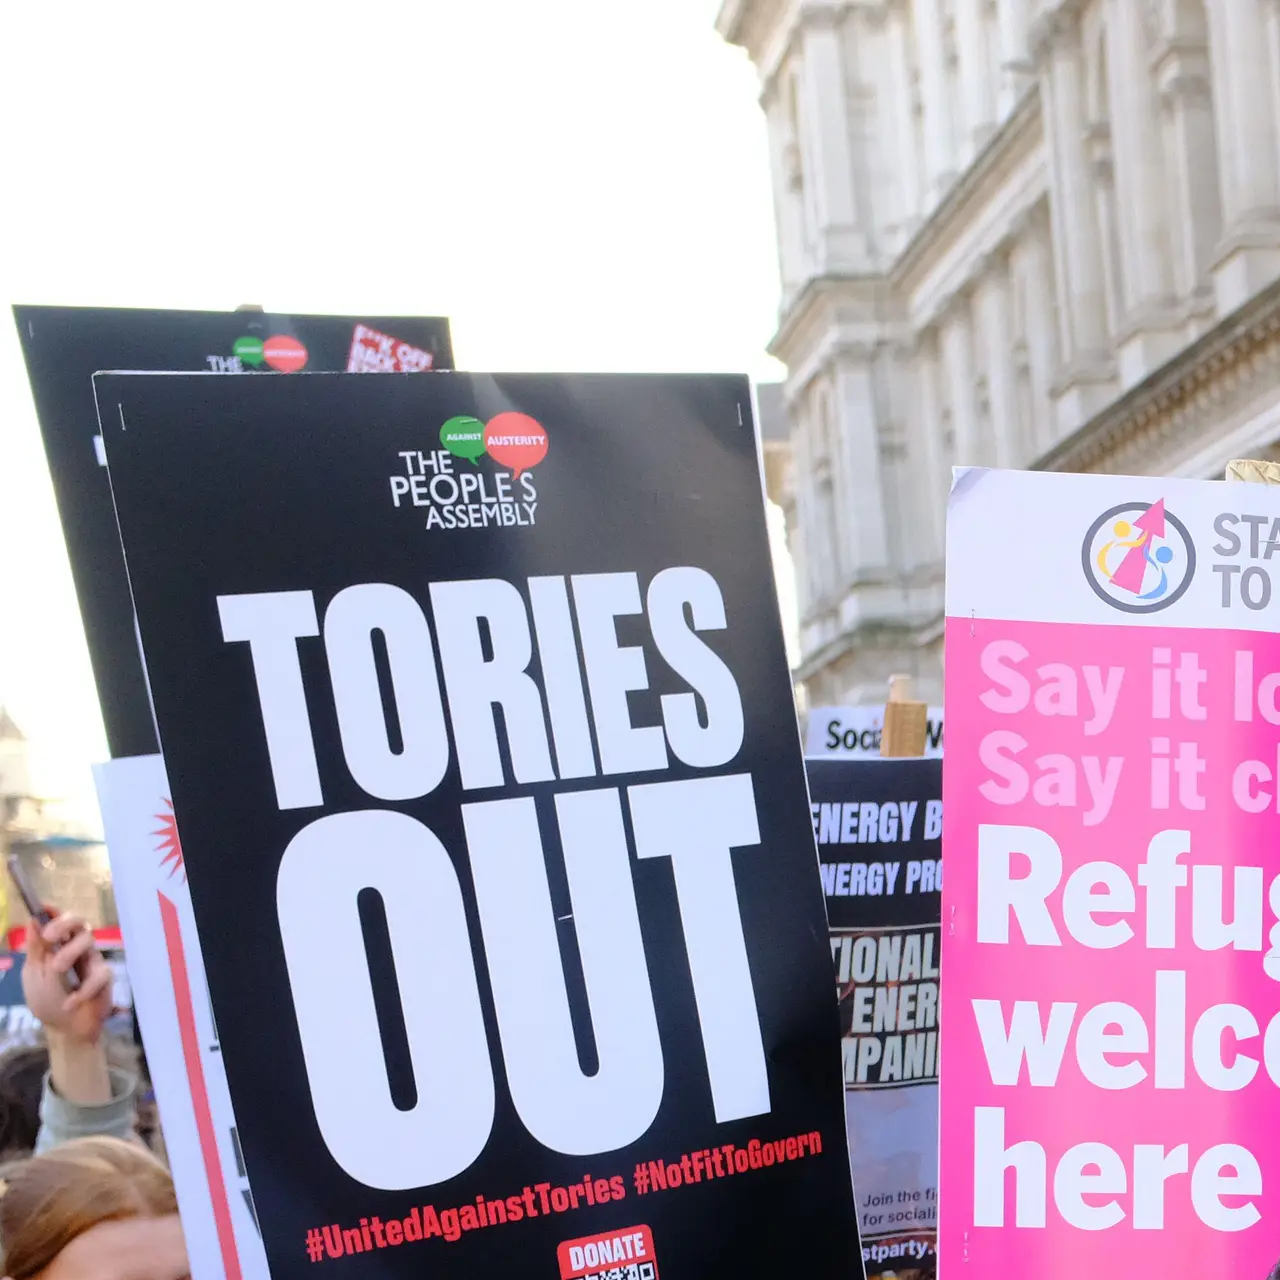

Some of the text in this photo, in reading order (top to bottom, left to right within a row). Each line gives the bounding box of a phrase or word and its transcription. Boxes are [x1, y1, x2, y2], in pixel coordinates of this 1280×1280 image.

[446, 432, 482, 442] AGAINST
[487, 435, 545, 447] AUSTERITY
[398, 450, 454, 475] THE
[425, 502, 538, 531] ASSEMBLY
[1212, 564, 1272, 611] TO
[216, 565, 744, 811] TORIES
[978, 638, 1127, 737] Say
[1151, 647, 1207, 721] it
[977, 729, 1125, 827] Say
[1151, 736, 1207, 811] it
[820, 861, 901, 896] NERGY
[275, 773, 772, 1191] OUT
[852, 982, 940, 1033] ENER
[972, 1106, 1263, 1232] here
[305, 1130, 822, 1262] #UnitedAgainstTories #NotFitToGovern
[863, 1193, 893, 1207] Join
[898, 1190, 920, 1203] the
[863, 1205, 937, 1226] for sociali
[568, 1231, 646, 1272] DONATE
[862, 1239, 938, 1264] stparty.
